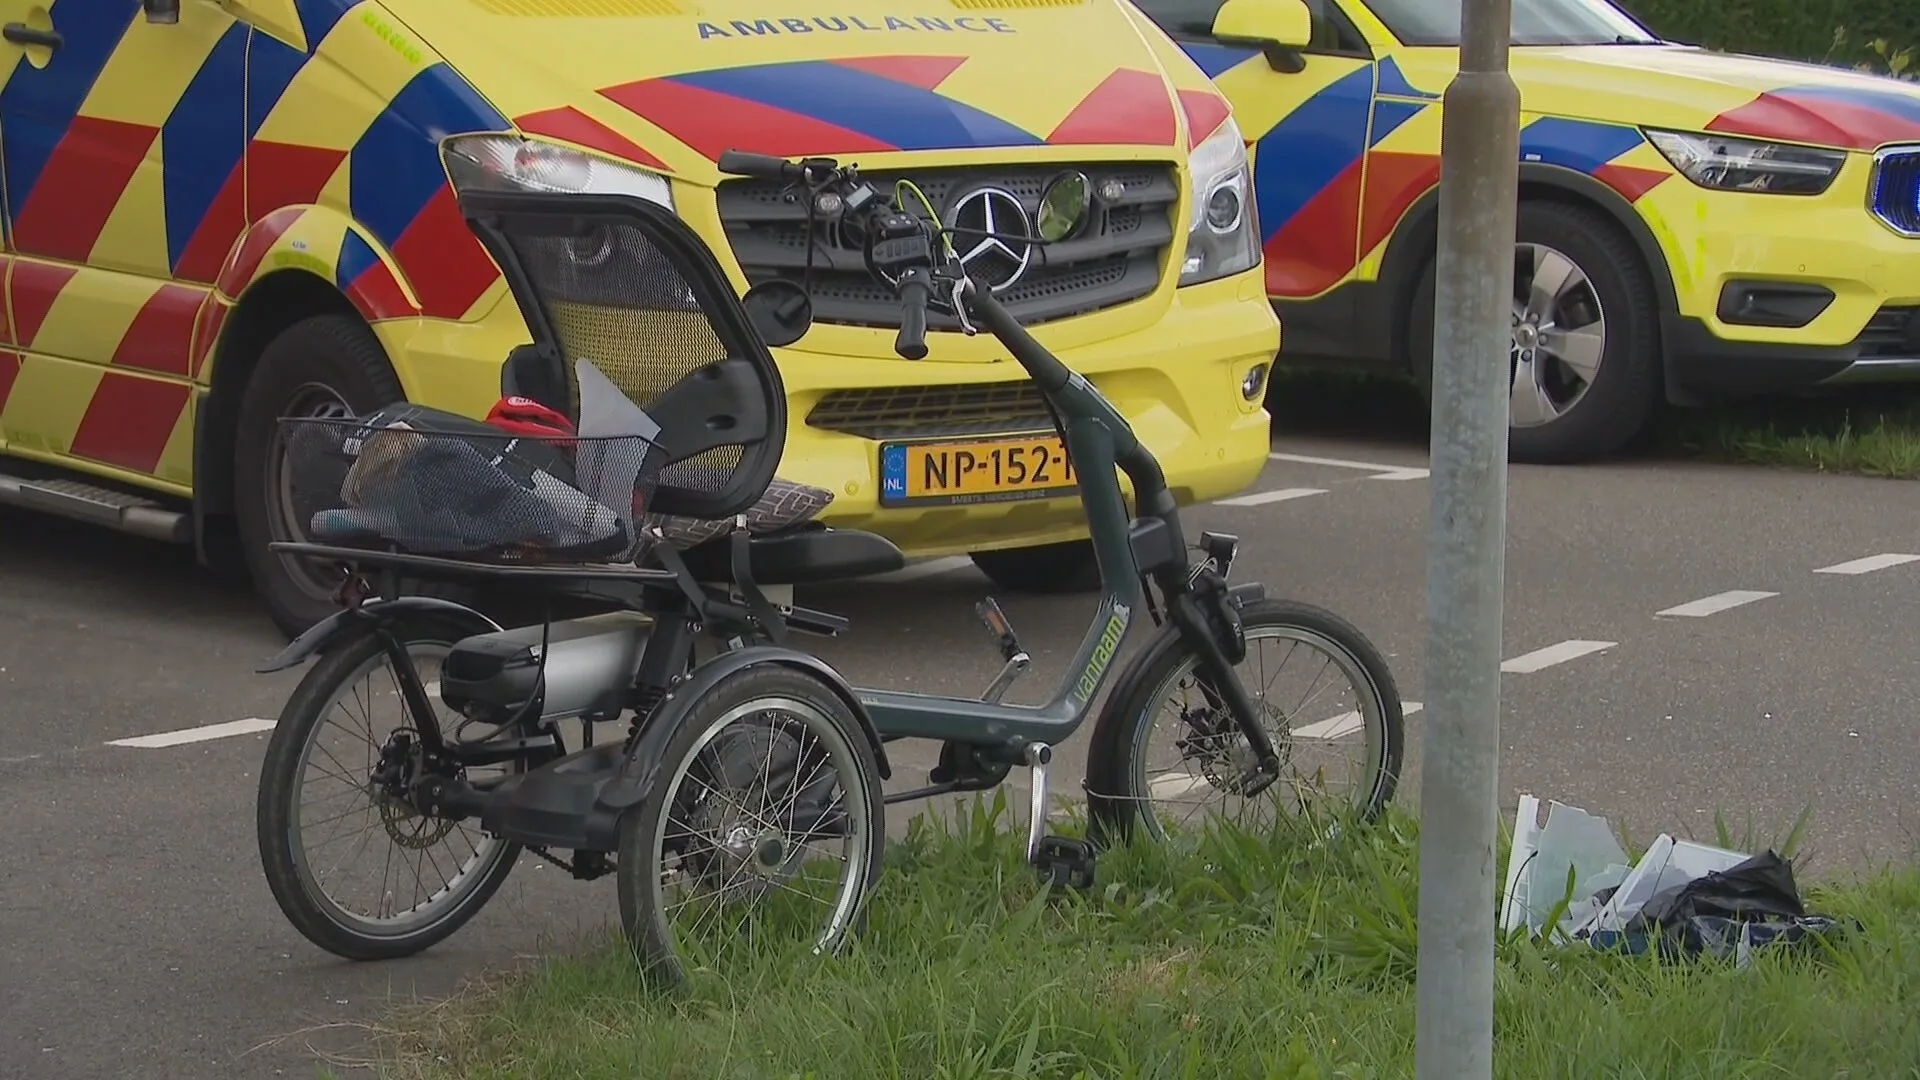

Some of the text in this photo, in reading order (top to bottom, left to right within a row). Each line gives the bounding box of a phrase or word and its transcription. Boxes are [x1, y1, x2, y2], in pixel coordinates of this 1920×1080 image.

[697, 16, 1017, 39] AMBULANCE
[887, 477, 904, 490] NL
[1074, 615, 1125, 702] vanraam
